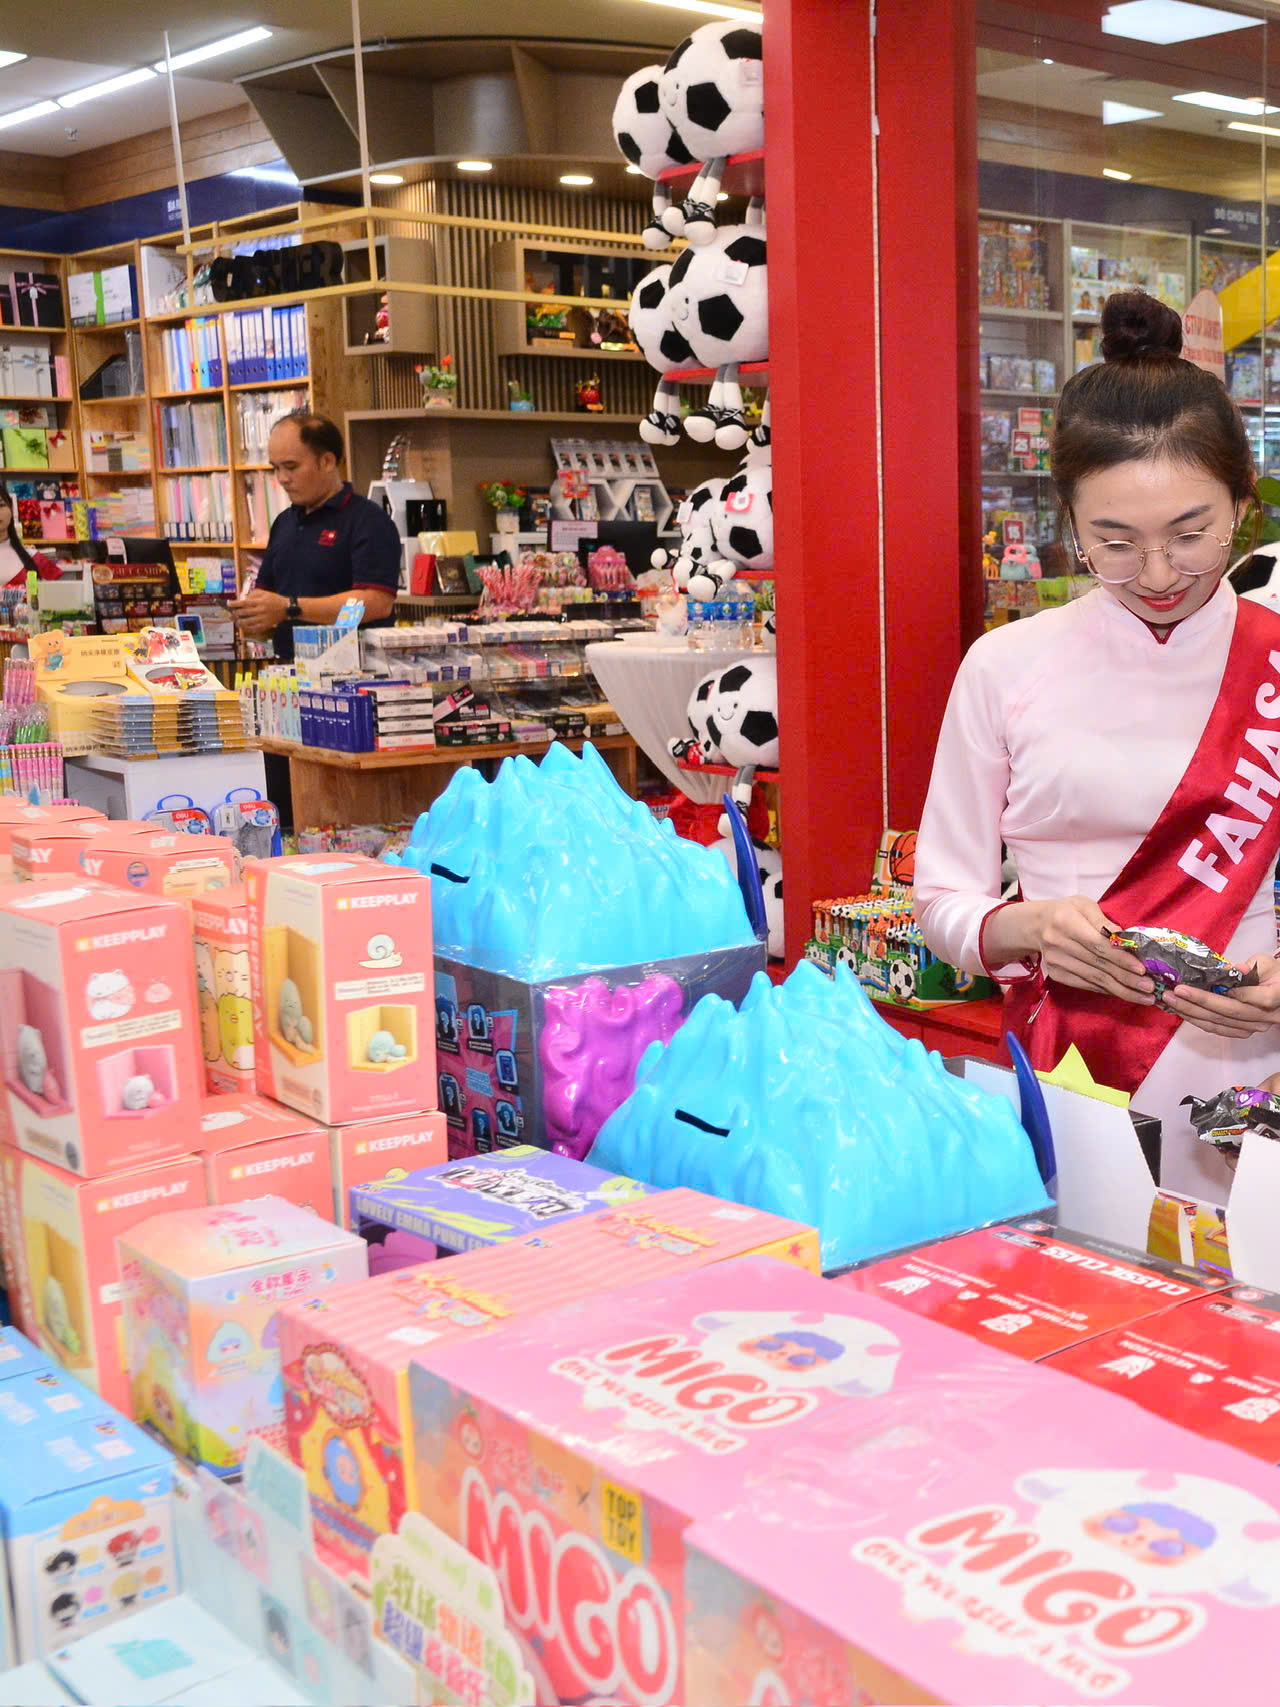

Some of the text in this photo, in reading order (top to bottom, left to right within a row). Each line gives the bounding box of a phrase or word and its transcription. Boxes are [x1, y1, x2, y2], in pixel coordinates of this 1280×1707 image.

[350, 892, 418, 909] KEEPPLAY
[92, 925, 167, 950] KEEPPLAY
[368, 1131, 434, 1152] KEEPPLAY
[245, 1151, 315, 1177] KEEPPLAY
[113, 1180, 189, 1209] KEEPPLAY
[356, 1196, 394, 1222] LOVELY
[395, 1211, 431, 1238] EMMA
[433, 1223, 465, 1250] PUNK
[1040, 1246, 1107, 1272] CLASS
[902, 1263, 968, 1289] MEGATRON
[1103, 1264, 1191, 1296] CLASSIC
[1029, 1308, 1089, 1332] OPTIMUS
[1119, 1339, 1197, 1370] MEGATRON
[600, 1335, 810, 1426] MIGO
[1221, 1375, 1272, 1395] PRIME
[606, 1487, 636, 1521] TOP
[607, 1517, 636, 1553] TOY
[463, 1473, 674, 1701] MIGO
[915, 1508, 1196, 1651] MIGO
